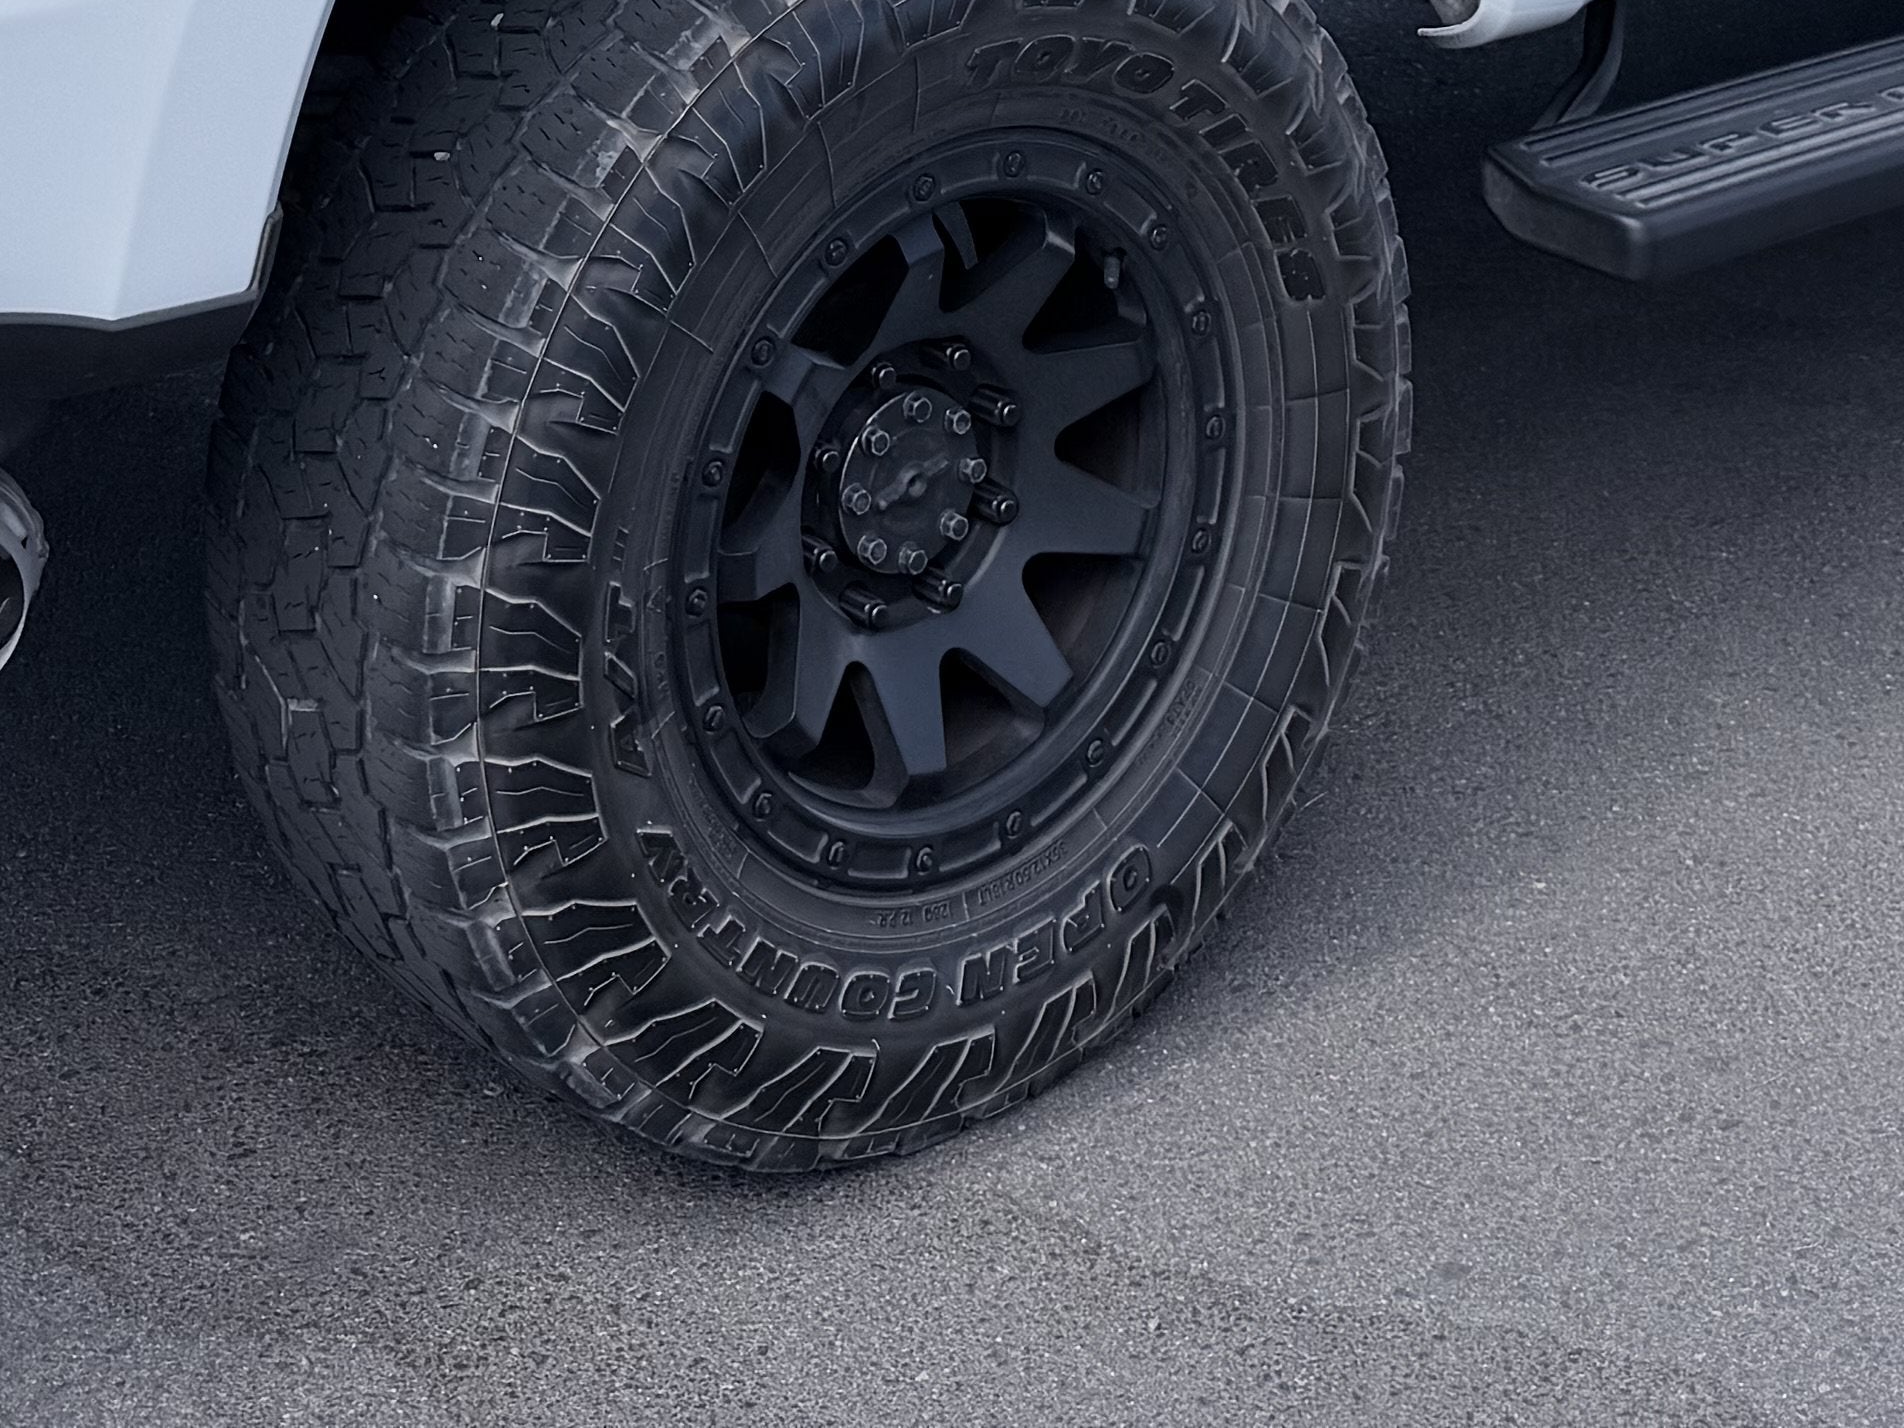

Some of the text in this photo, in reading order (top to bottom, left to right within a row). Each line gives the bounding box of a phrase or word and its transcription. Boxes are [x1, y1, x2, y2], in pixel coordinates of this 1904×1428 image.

[965, 33, 1175, 95] TOYO
[1170, 78, 1327, 303] TIRES
[1580, 101, 1877, 189] SUPER
[636, 825, 938, 1021] COUNTRY
[954, 844, 1153, 1007] OPEN
